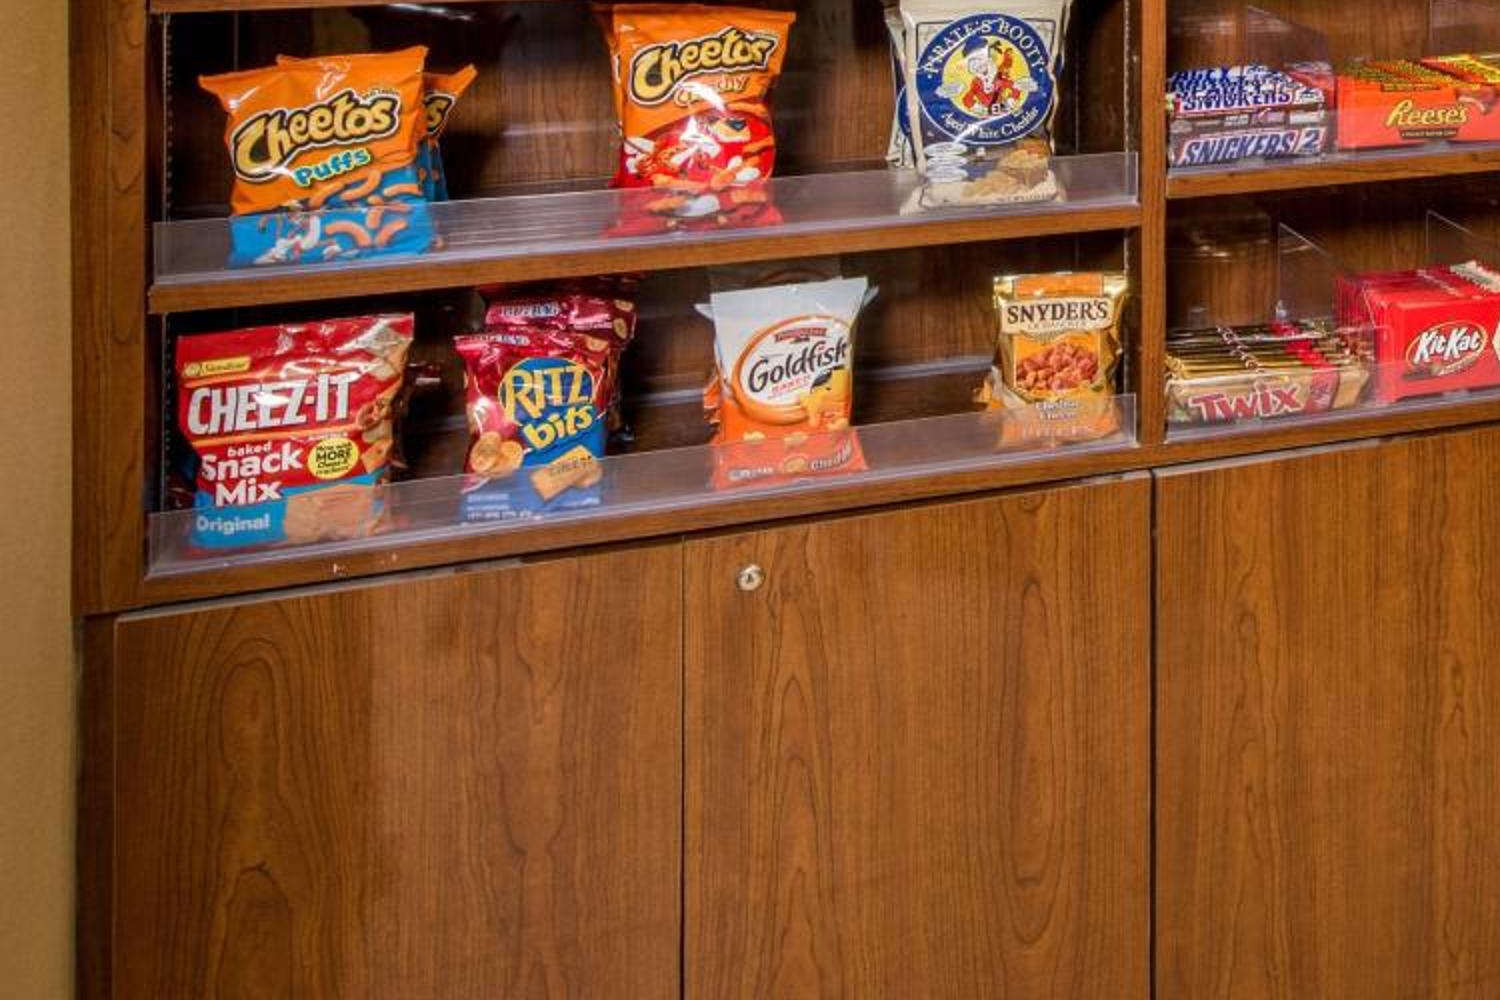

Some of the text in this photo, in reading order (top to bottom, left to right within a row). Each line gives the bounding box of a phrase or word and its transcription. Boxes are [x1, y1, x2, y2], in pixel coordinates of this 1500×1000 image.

[632, 26, 778, 104] Cheetos
[923, 16, 1047, 75] PIRATE'S BOOTY
[1385, 99, 1470, 128] Reese's
[233, 90, 400, 181] Cheetos
[292, 147, 372, 186] Puffs
[1006, 300, 1109, 325] SNYDER'S
[749, 336, 848, 393] Goldfish
[187, 372, 362, 435] CHEEZ-IT
[504, 365, 589, 420] RITZ
[523, 404, 594, 450] bits
[201, 442, 304, 482] Snack
[227, 440, 272, 458] baked
[315, 449, 352, 462] MORE
[214, 477, 283, 508] Mix
[195, 513, 271, 535] Original
